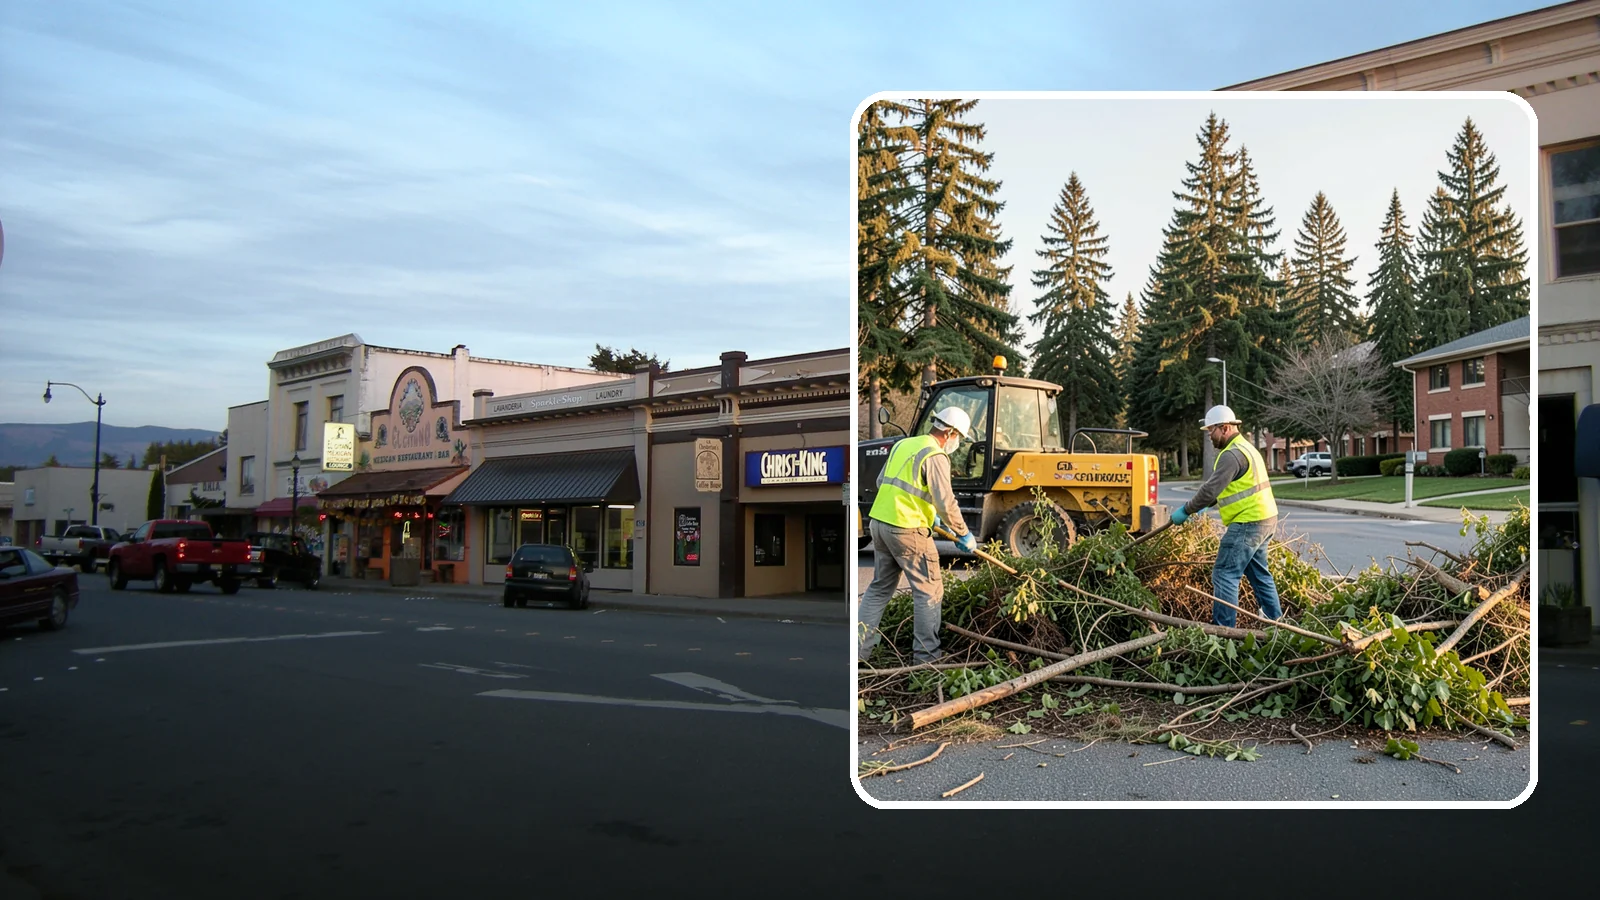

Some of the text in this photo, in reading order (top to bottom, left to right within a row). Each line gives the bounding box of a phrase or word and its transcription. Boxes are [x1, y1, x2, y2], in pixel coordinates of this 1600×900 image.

[493, 401, 523, 412] LAVANDERIA
[562, 394, 583, 407] Shop
[595, 388, 624, 399] LAUNDRY
[373, 450, 450, 464] MEXICAN RESTAURANT BAR
[761, 449, 827, 478] CHRIST KING
